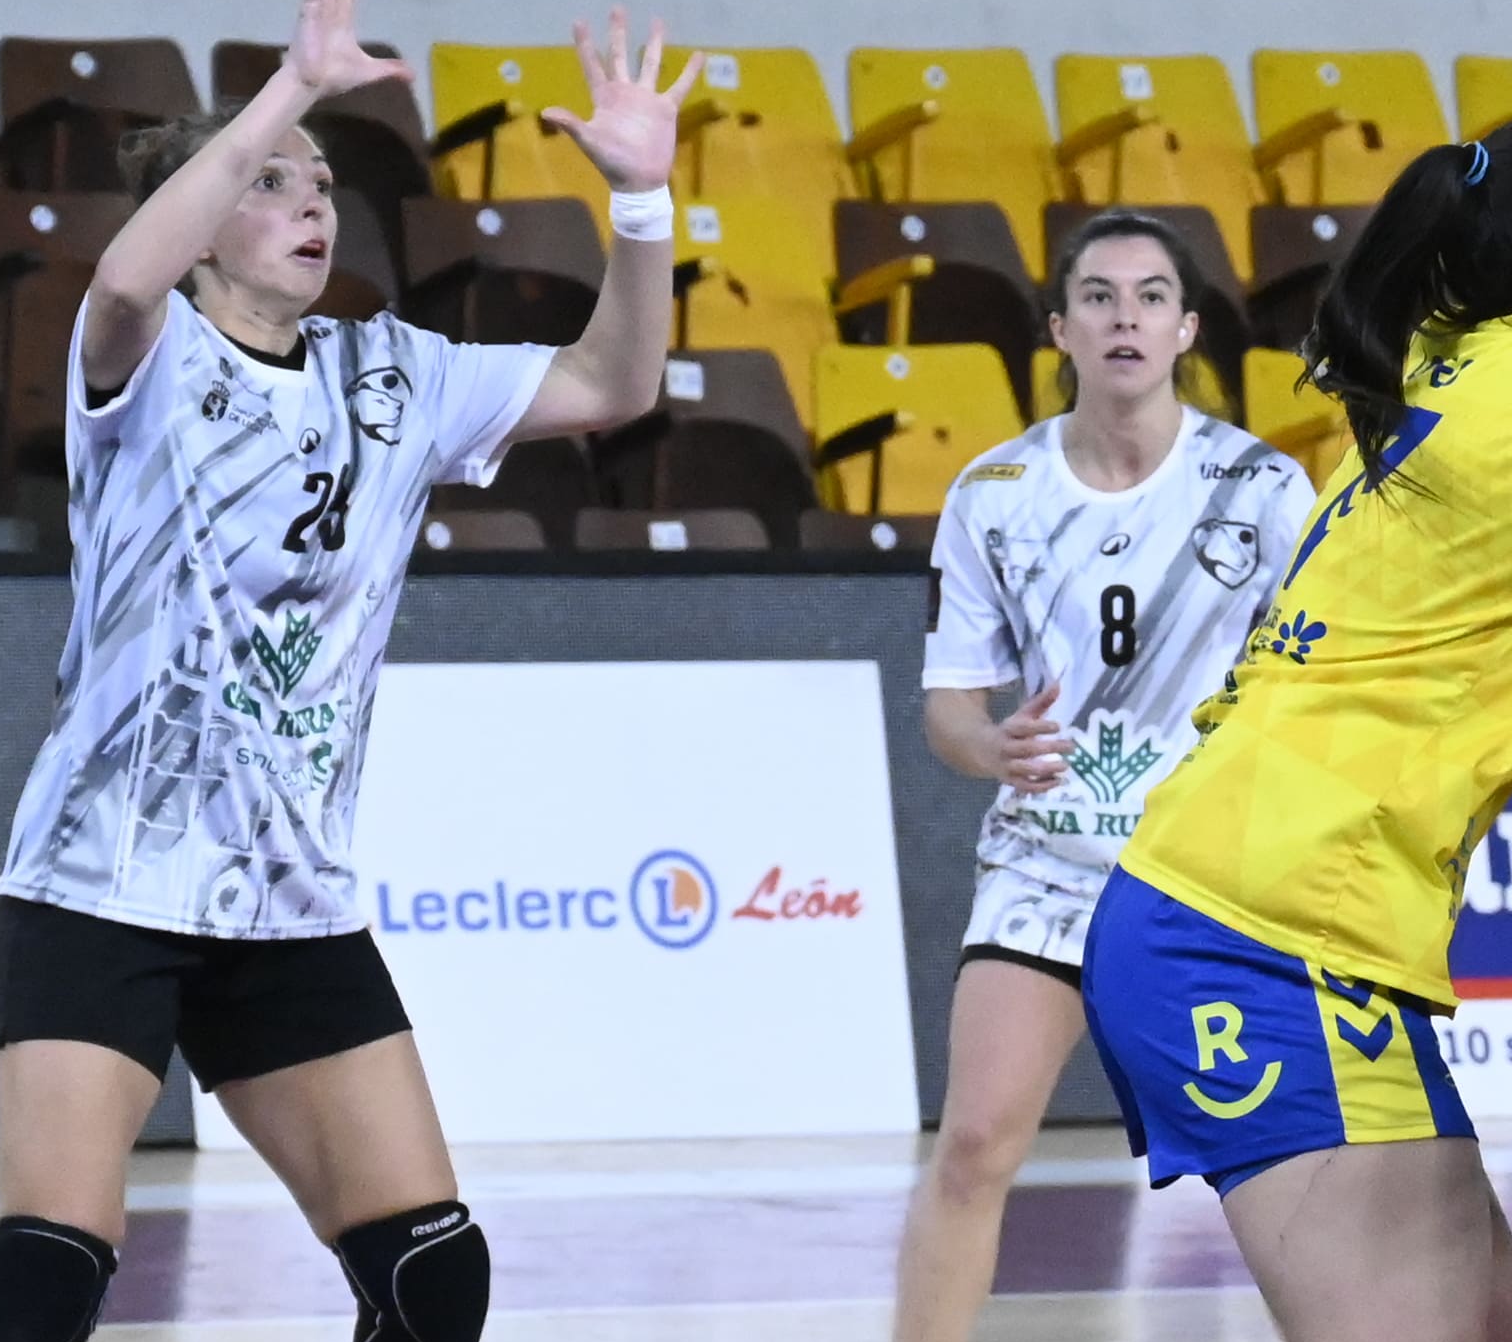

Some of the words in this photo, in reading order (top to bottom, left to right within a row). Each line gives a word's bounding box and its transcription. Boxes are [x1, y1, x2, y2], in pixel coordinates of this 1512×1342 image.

[1100, 585, 1136, 667] 8
[377, 879, 619, 933] Leclerc
[731, 866, 863, 921] León
[1190, 1001, 1247, 1069] R
